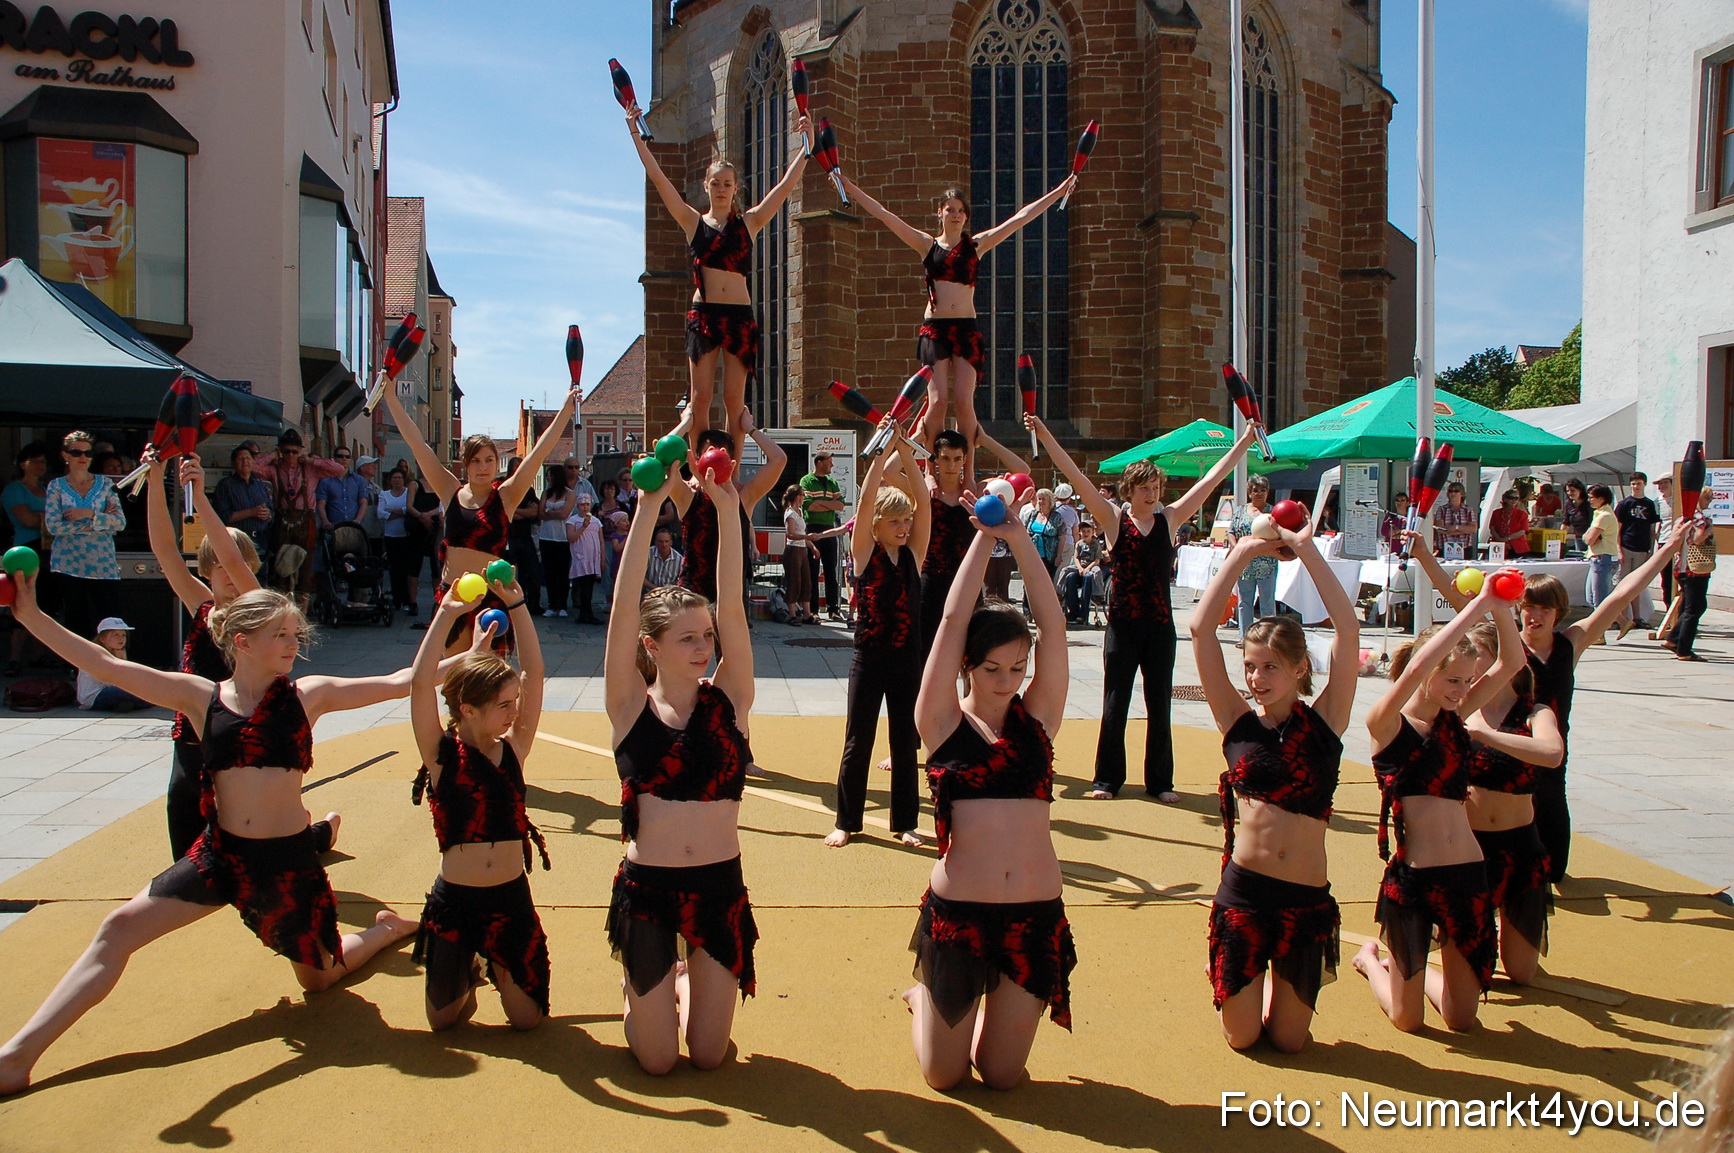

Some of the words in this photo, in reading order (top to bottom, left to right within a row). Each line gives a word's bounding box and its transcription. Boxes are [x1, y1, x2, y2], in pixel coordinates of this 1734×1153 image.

[15, 63, 60, 81] am
[66, 59, 176, 91] Rathaus
[402, 383, 410, 394] M
